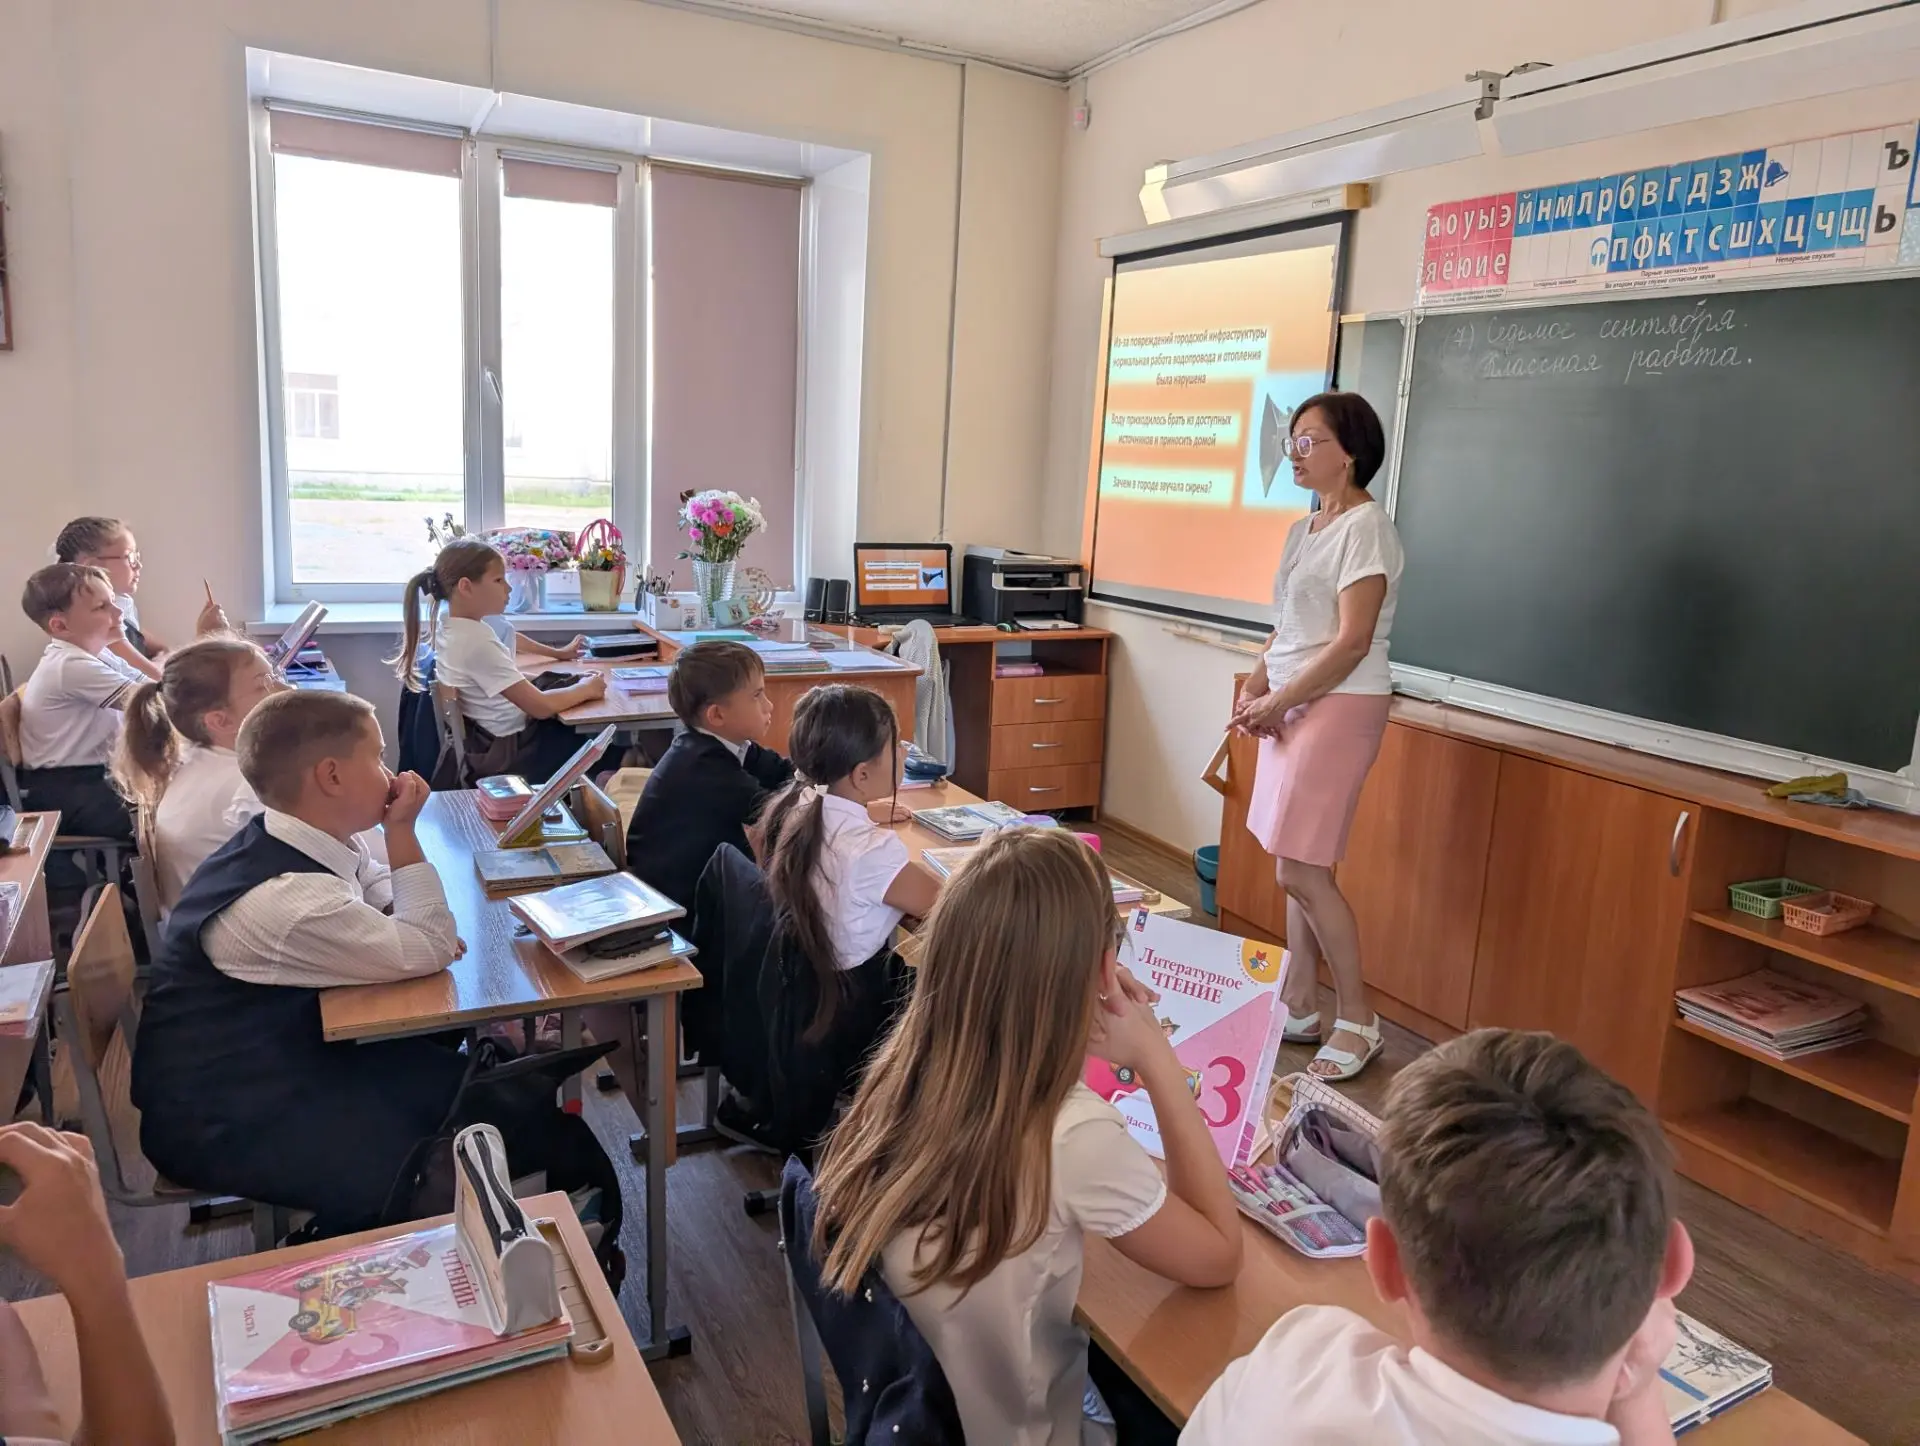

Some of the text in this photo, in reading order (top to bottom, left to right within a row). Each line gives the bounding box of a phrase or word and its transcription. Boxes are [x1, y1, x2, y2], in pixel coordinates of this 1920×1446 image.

[1776, 255, 1811, 264] Непарные
[1130, 332, 1174, 349] повреждений
[1175, 330, 1208, 346] городской
[1209, 328, 1267, 344] инфраструктуры
[1113, 356, 1149, 368] нормальная
[1150, 353, 1172, 368] работа
[1173, 353, 1216, 367] водопровода
[1223, 350, 1262, 363] отопления
[1156, 372, 1206, 388] была нарушена
[1111, 412, 1232, 428] Воду приходилось брать из доступных
[1118, 435, 1153, 446] источников
[1160, 435, 1192, 447] приносить
[1193, 433, 1217, 448] домой
[1113, 476, 1132, 489] Зачем
[1137, 480, 1160, 492] городе
[1160, 481, 1185, 494] звучала
[1185, 481, 1213, 495] сирена?
[1138, 947, 1243, 990] Литературное
[1151, 970, 1223, 1004] ЧТЕНИЕ
[1199, 1056, 1246, 1128] 3
[1126, 1115, 1154, 1132] Часть
[441, 1248, 477, 1308] ЧТЕНИЕ
[244, 1304, 256, 1332] Часть
[290, 1333, 399, 1377] 3
